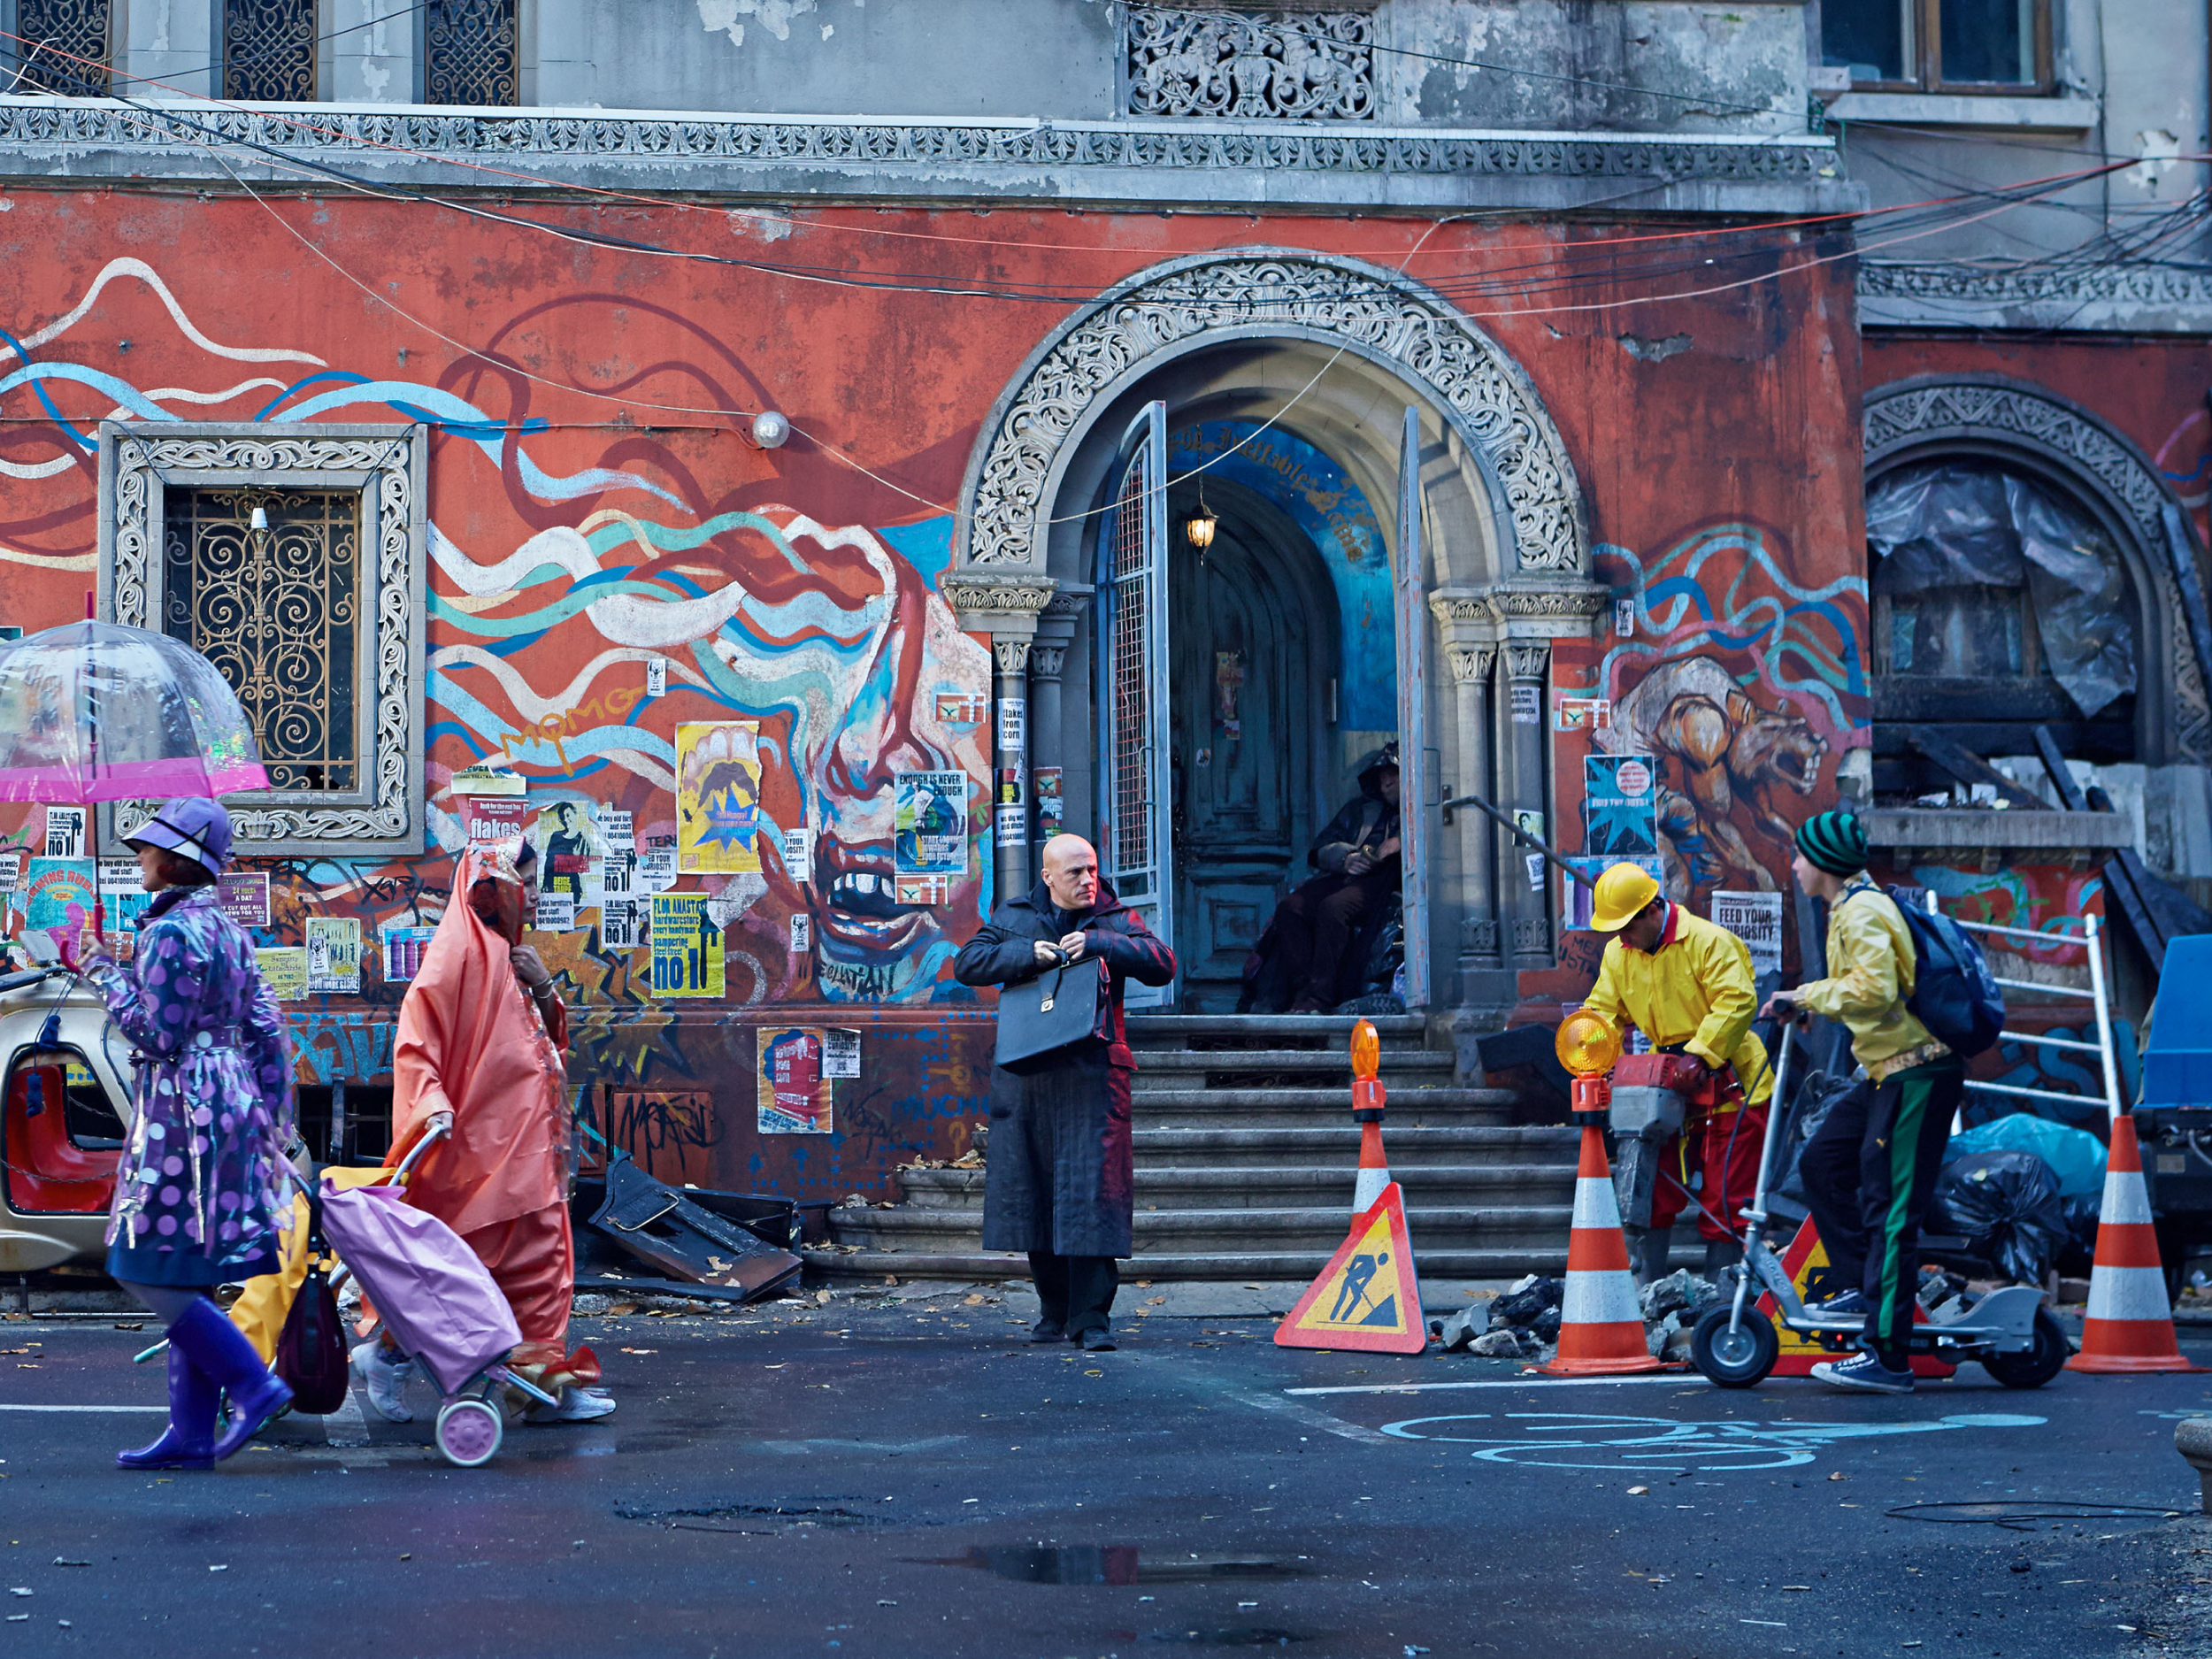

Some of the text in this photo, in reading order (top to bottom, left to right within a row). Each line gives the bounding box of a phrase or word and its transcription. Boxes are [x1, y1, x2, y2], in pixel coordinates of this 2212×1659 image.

[1003, 730, 1020, 740] corn
[900, 774, 961, 785] ENOUGH IS NEVER
[933, 786, 963, 796] ENOUGH
[471, 818, 521, 839] flakes
[49, 840, 63, 856] no
[656, 854, 670, 863] YOUR
[604, 876, 618, 892] no
[654, 897, 670, 914] FLOR
[1719, 908, 1772, 924] FEED YOUR
[605, 927, 619, 943] no
[1720, 925, 1773, 942] URIOSITY
[654, 936, 688, 949] pampering
[654, 948, 698, 990] no 1
